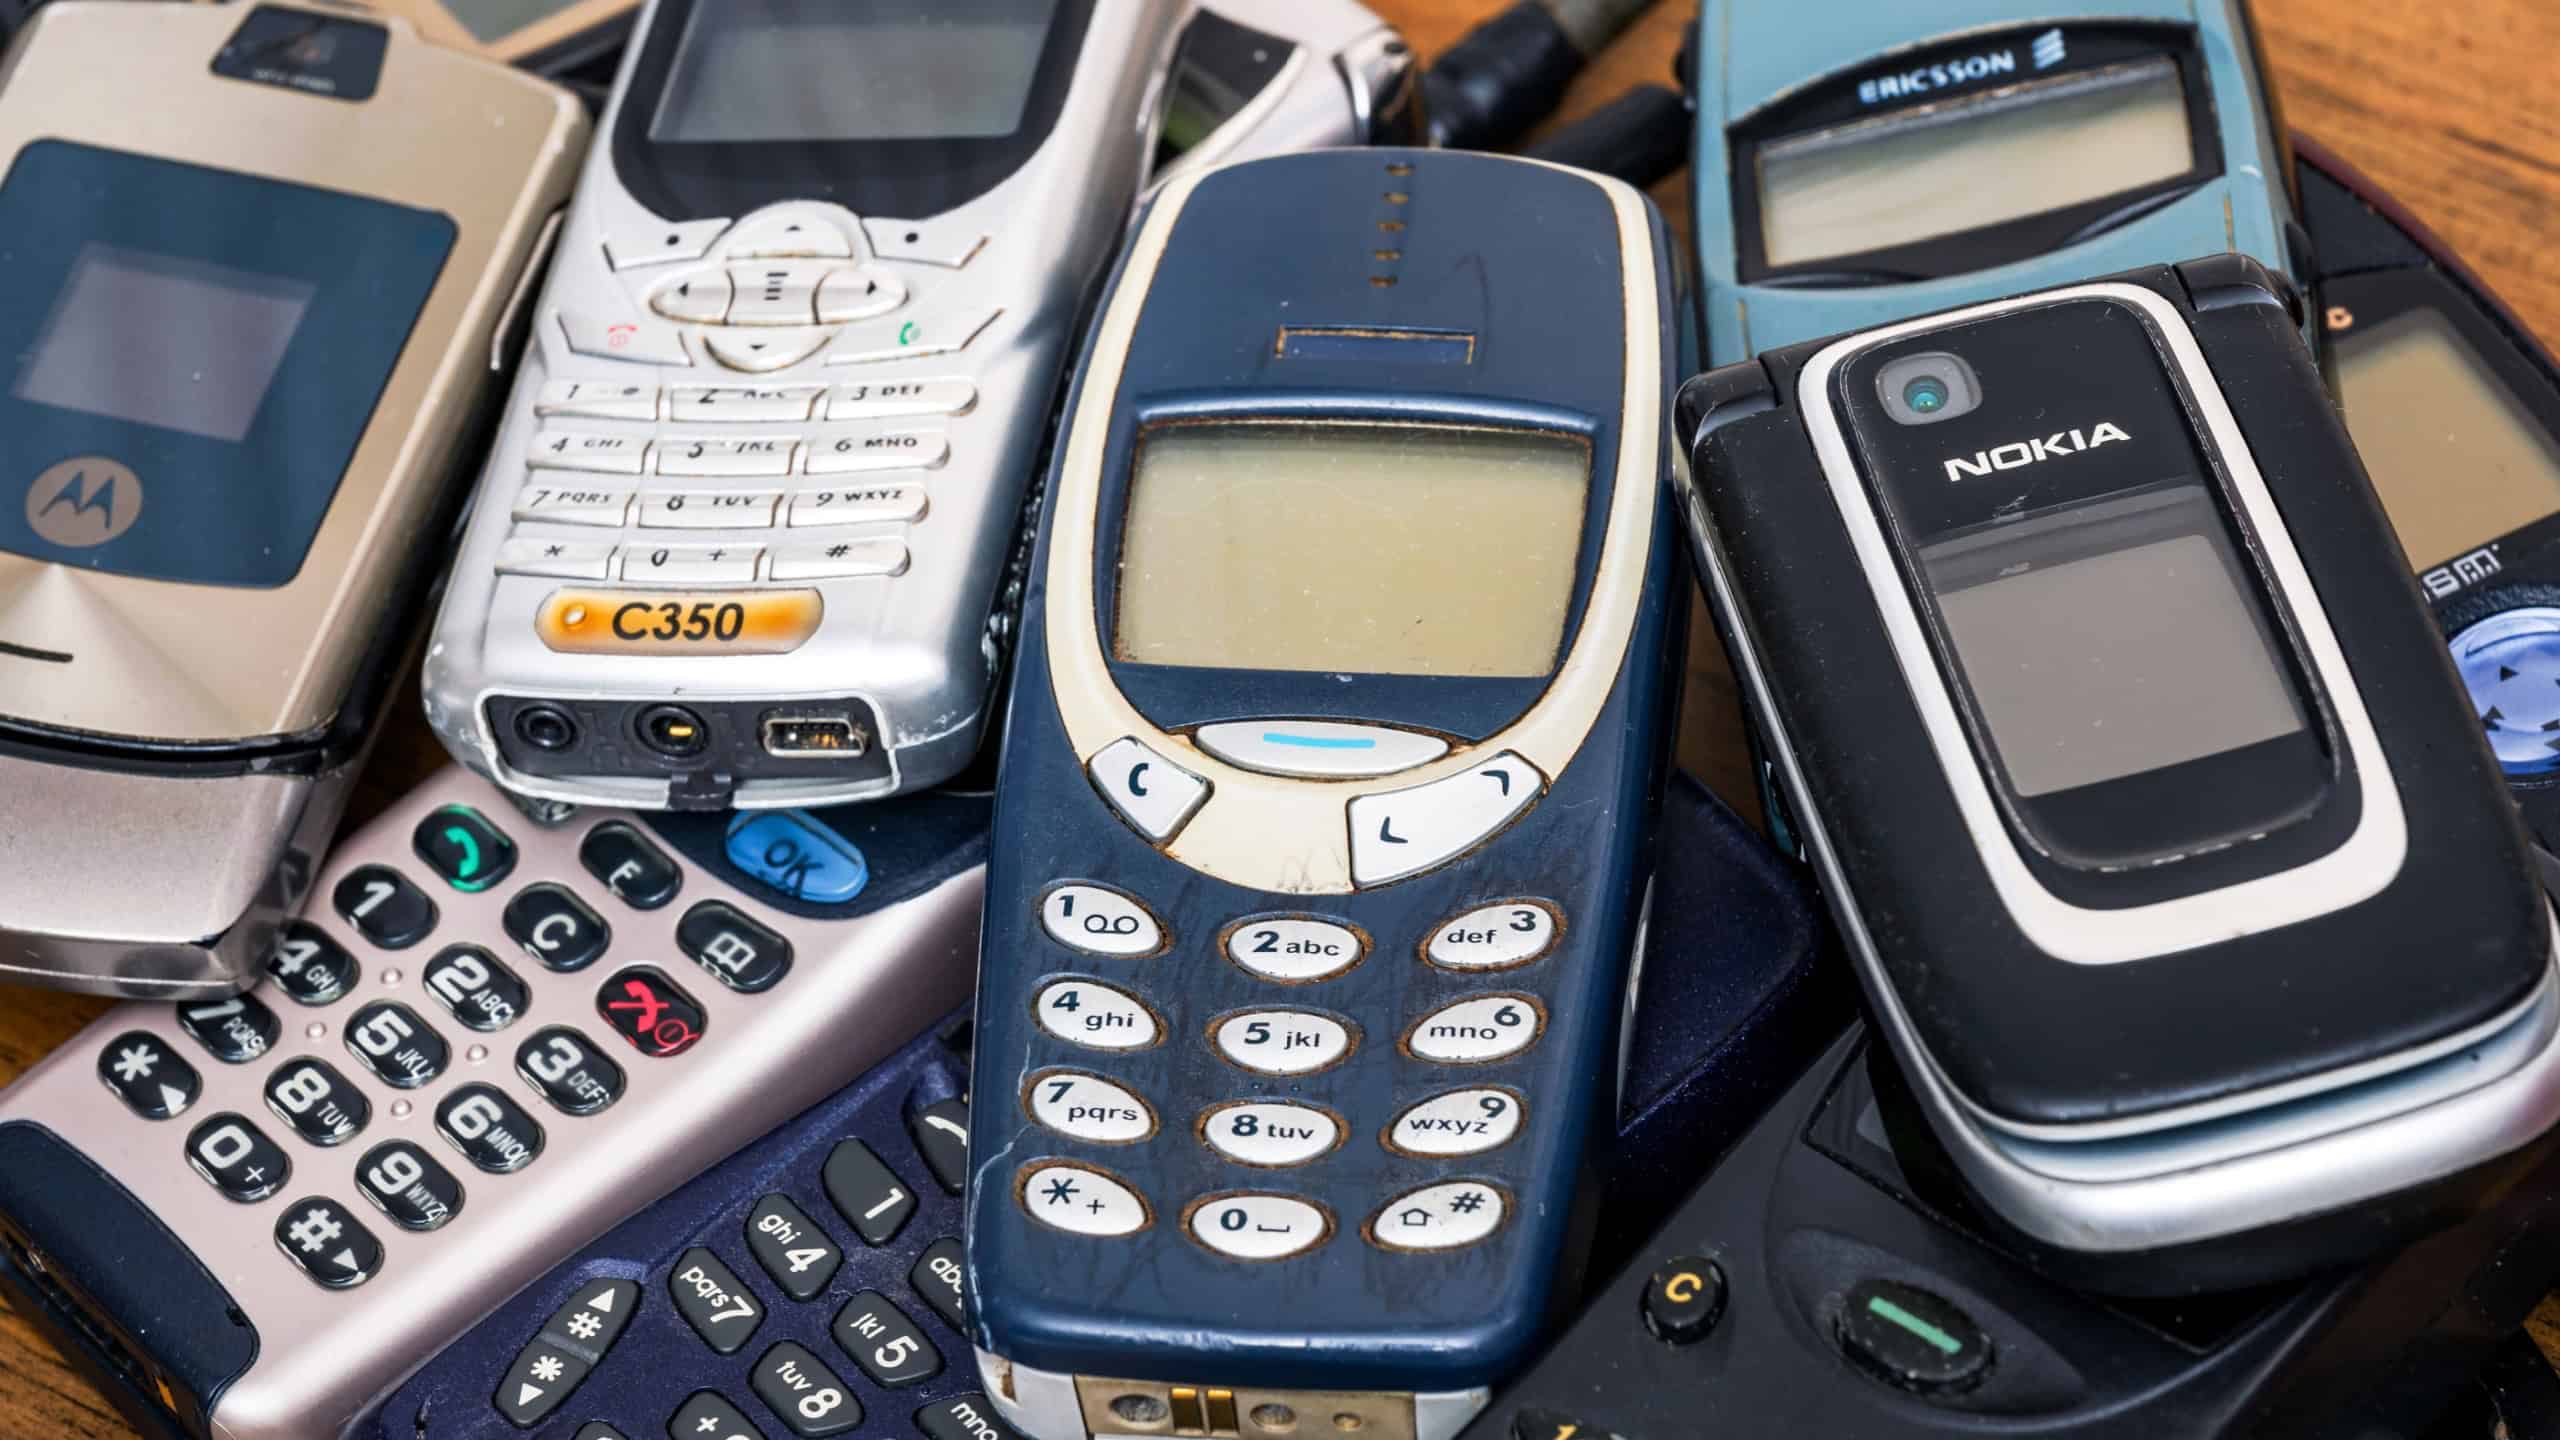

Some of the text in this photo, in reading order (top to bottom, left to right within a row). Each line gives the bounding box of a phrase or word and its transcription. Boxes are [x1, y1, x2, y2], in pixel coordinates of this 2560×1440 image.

[1859, 49, 2015, 103] ERICSSON
[699, 388, 718, 404] 2
[851, 385, 925, 401] 3 DEF
[551, 438, 569, 453] 4
[687, 441, 706, 459] 5
[835, 436, 918, 452] 6 MNO
[1943, 421, 2132, 482] NOKIA
[535, 490, 612, 507] 7 PQRS
[712, 495, 758, 507] TUV
[816, 489, 903, 507] 9 WXYZ
[651, 550, 669, 567] 0
[2423, 548, 2501, 604] SM
[612, 602, 745, 641] C350
[763, 838, 824, 886] OK
[353, 881, 395, 918] 1
[1058, 894, 1076, 918] 1
[533, 913, 576, 951] C
[1252, 931, 1340, 957] 2 abc
[1446, 911, 1537, 945] def 3
[430, 955, 512, 1022] 2 ABC
[1052, 991, 1134, 1031] 4 ghi
[1429, 1005, 1522, 1041] mno 6
[355, 1009, 430, 1078] 5 JKL
[1243, 1022, 1320, 1050] 5 jkl
[526, 1036, 605, 1103] 3 DEF
[275, 1067, 355, 1136] 8 TUV
[1046, 1082, 1138, 1123] 7 pqrs
[1410, 1096, 1507, 1137] wxyz 9
[447, 1094, 527, 1163] 6 MNO
[1231, 1115, 1314, 1141] 8 tuv
[368, 1151, 423, 1195] 9
[863, 1187, 906, 1220] 1
[1220, 1209, 1248, 1231] 0
[1449, 1191, 1486, 1215] #
[288, 1208, 343, 1251] #
[758, 1213, 828, 1273] ghi 4
[680, 1265, 755, 1323] pqrs 7
[1666, 1272, 1702, 1302] C
[566, 1312, 602, 1339] #
[849, 1313, 920, 1369] jkl 5
[775, 1361, 842, 1419] tuv 8
[949, 1400, 998, 1440] mno
